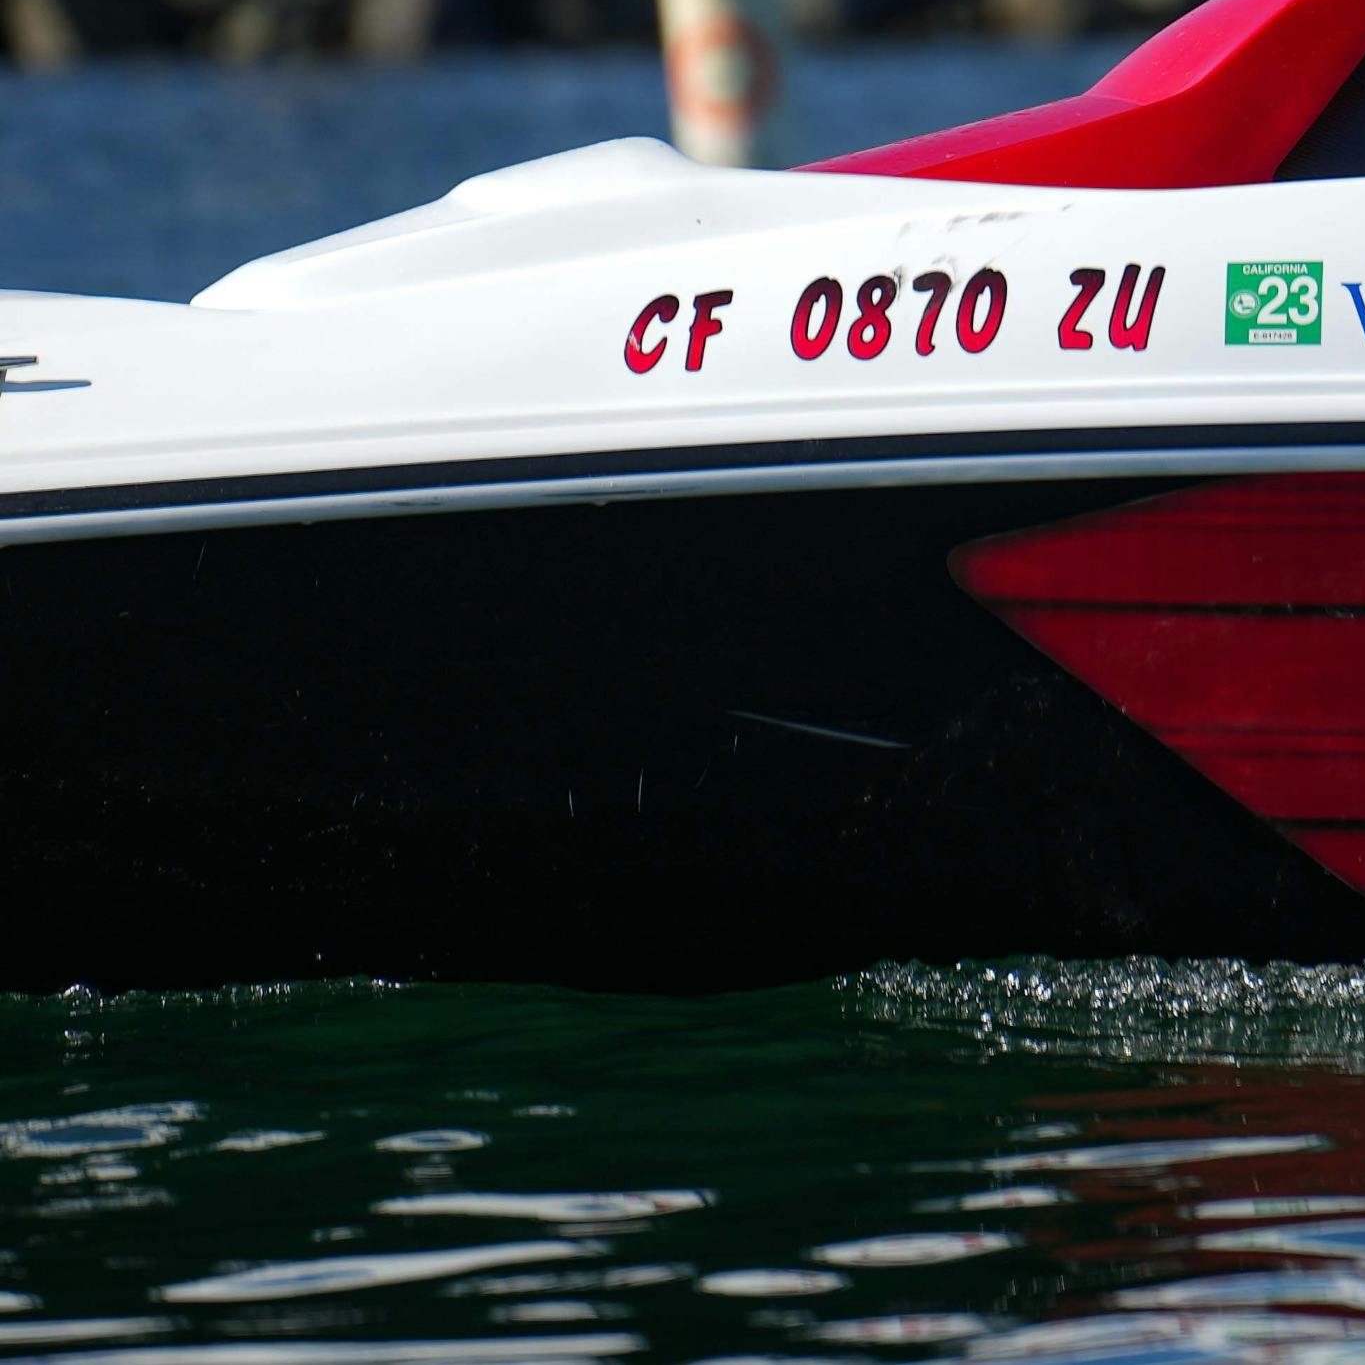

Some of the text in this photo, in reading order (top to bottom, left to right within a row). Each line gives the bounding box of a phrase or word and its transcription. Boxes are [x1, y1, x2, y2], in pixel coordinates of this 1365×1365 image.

[1242, 264, 1308, 276] CALIFORNIA
[623, 263, 1166, 374] CF 0870 ZU
[1256, 275, 1319, 326] 23
